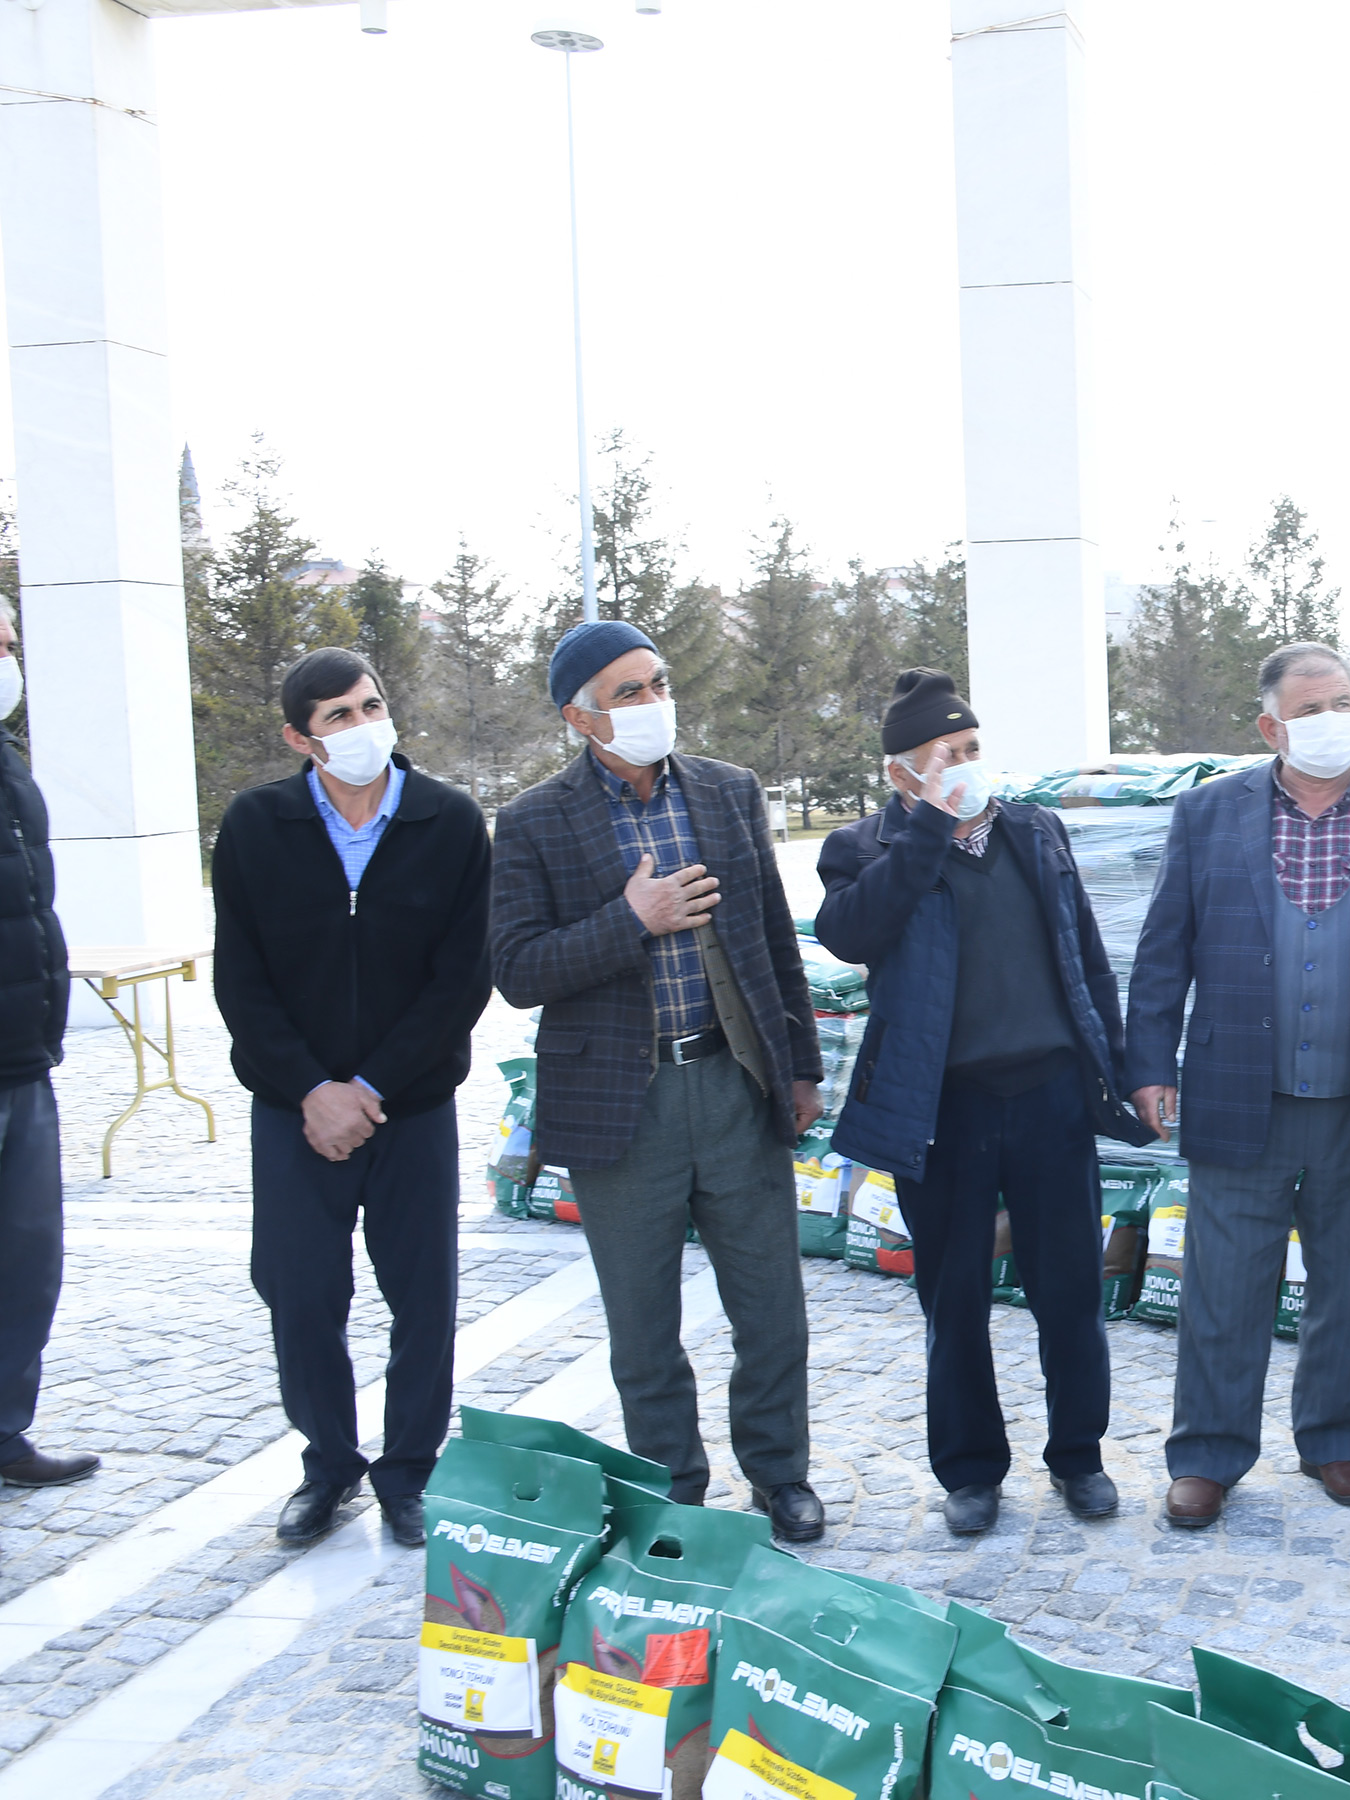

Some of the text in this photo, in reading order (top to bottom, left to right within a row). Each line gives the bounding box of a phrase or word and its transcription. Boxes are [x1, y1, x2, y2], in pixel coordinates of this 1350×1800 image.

[432, 1519, 562, 1564] PROELEMENT
[731, 1660, 870, 1741] PROELEMENT
[948, 1733, 1142, 1800] PROELEME
